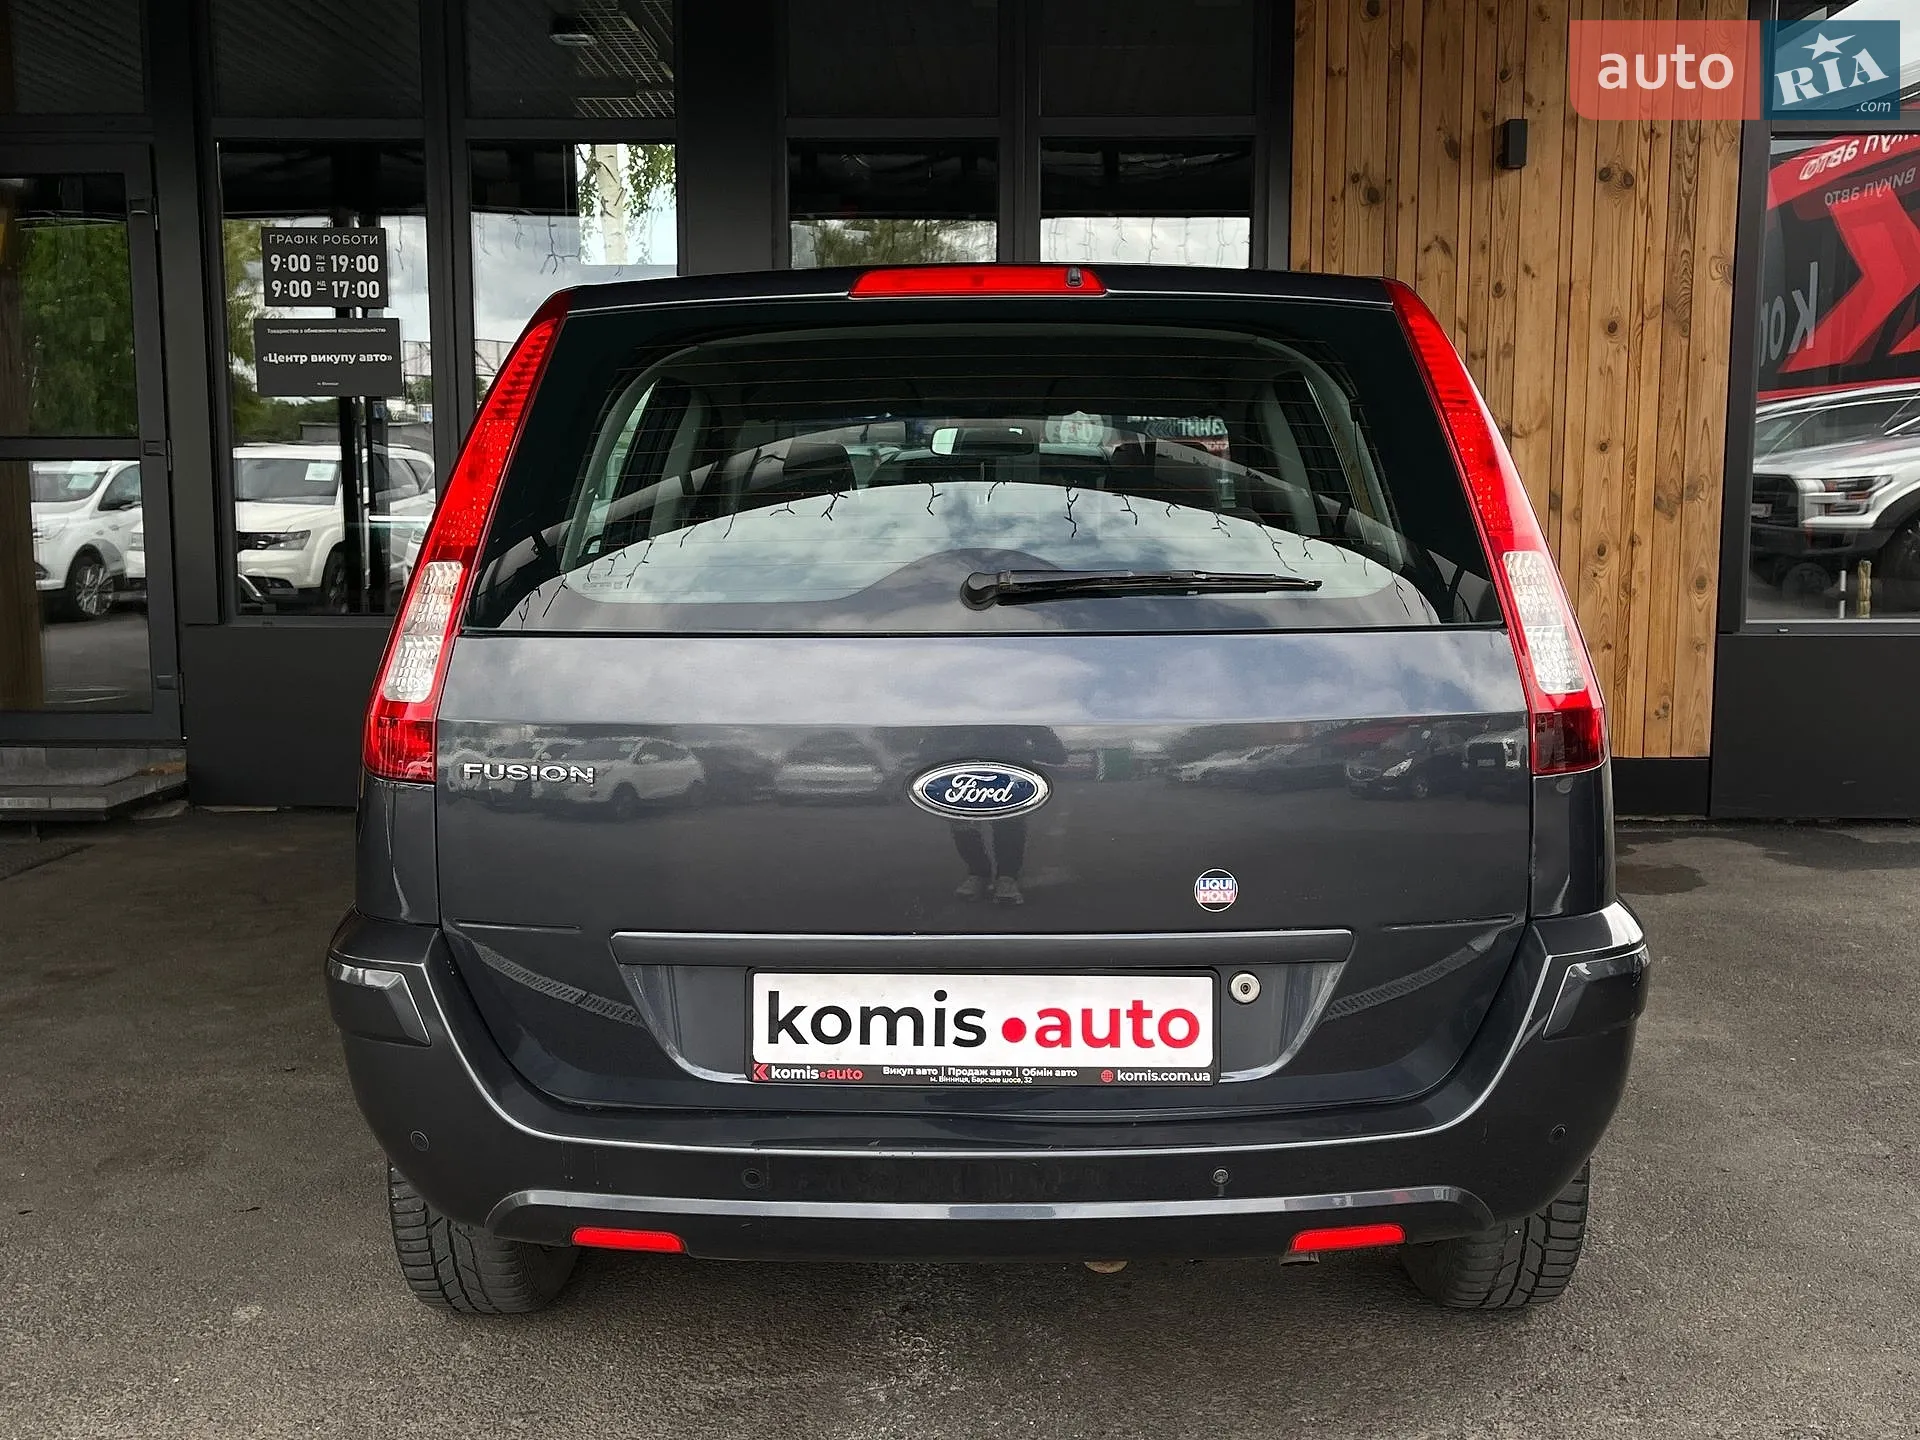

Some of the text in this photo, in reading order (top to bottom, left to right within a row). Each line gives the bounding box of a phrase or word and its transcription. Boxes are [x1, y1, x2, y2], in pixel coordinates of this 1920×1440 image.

[269, 234, 379, 245] ГРАФІК РОБОТИ
[270, 254, 379, 273] 9:00 19:00
[271, 280, 380, 299] 9:00 17:00
[262, 352, 393, 365] «Центр викупу авто»
[463, 763, 595, 784] FUSION
[944, 773, 1015, 803] Ford
[1199, 879, 1233, 890] LIQUI
[1199, 890, 1234, 901] MOLY
[882, 1066, 1078, 1078] Викуп авто Продаж авто Обмін авто
[1117, 1069, 1211, 1082] komis.com.ua
